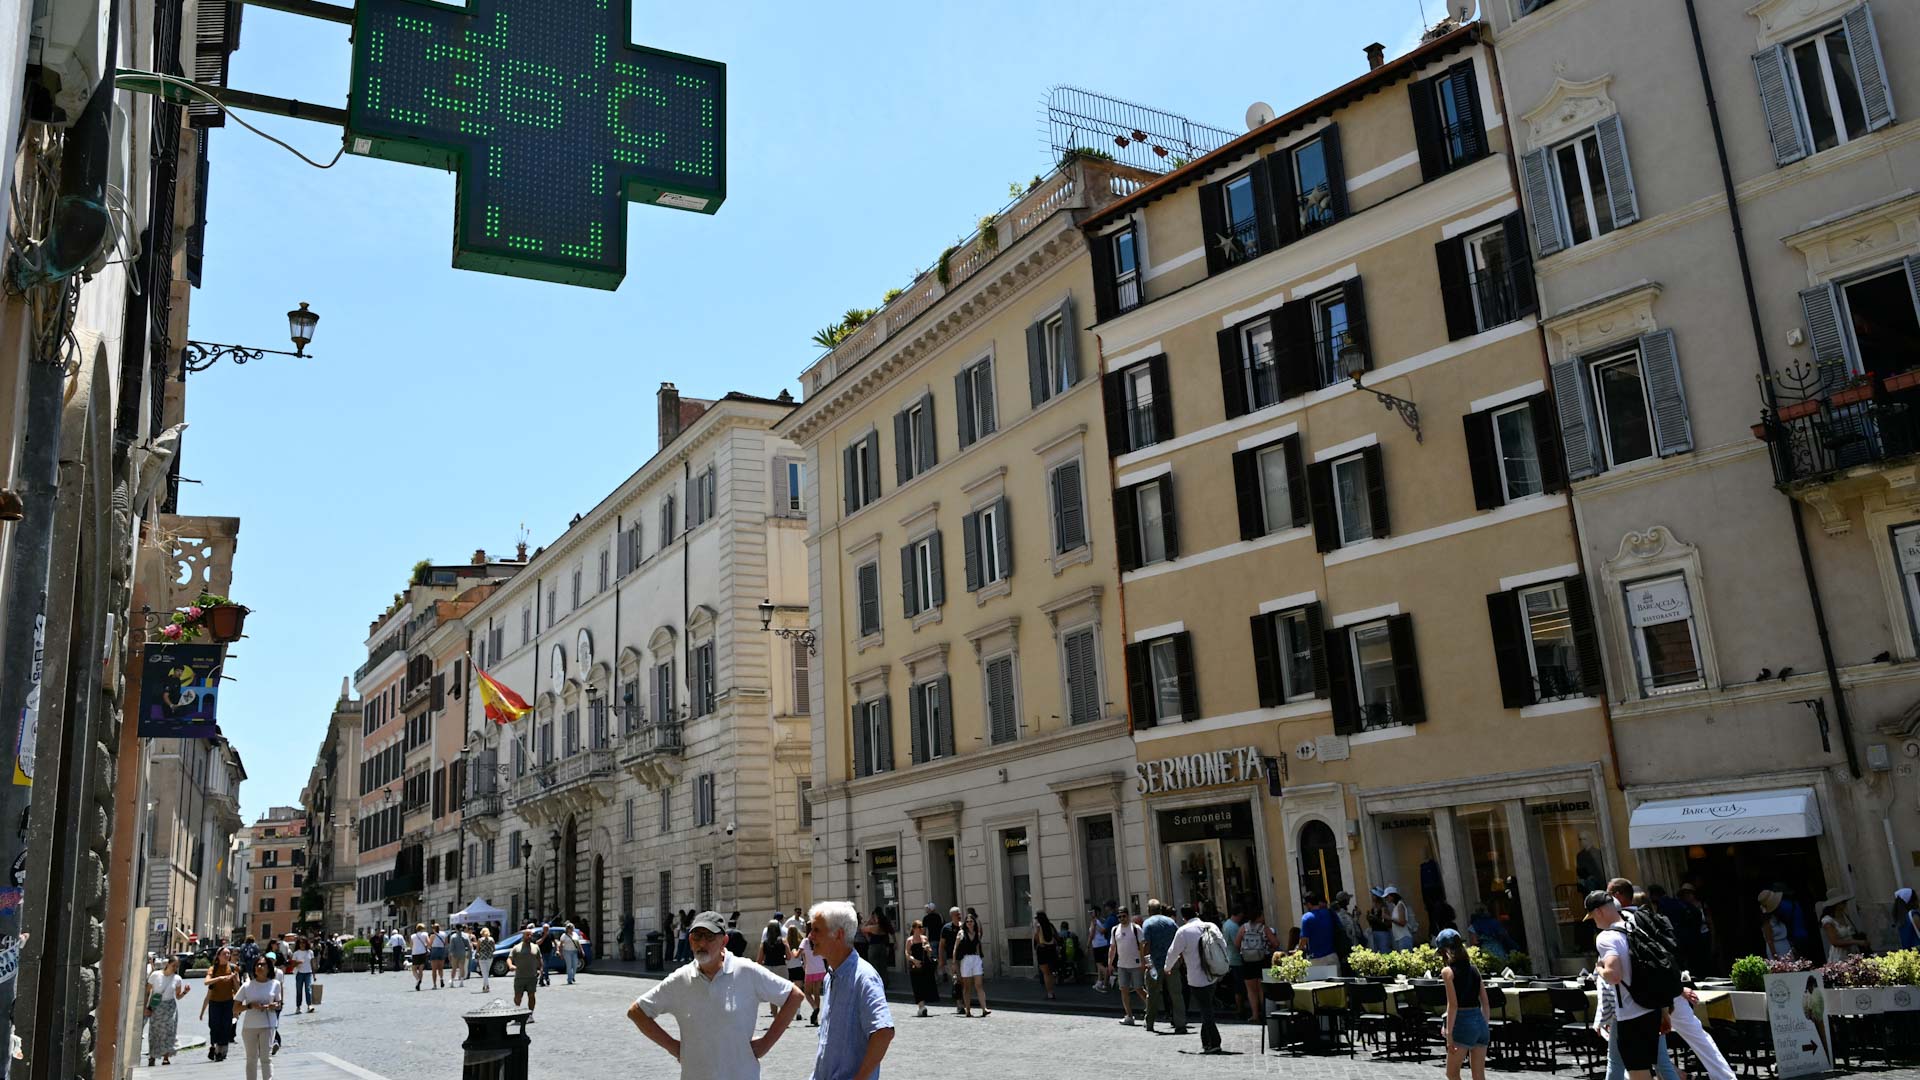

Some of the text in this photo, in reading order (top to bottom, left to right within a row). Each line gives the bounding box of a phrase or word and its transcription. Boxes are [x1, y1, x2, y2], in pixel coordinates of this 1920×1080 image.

[1637, 598, 1682, 612] BARCACCIA
[1642, 611, 1681, 622] RISTORANTE
[1136, 746, 1265, 795] SERMONETA
[1681, 803, 1747, 818] BARCACCIA
[1174, 811, 1232, 826] Sermoneta
